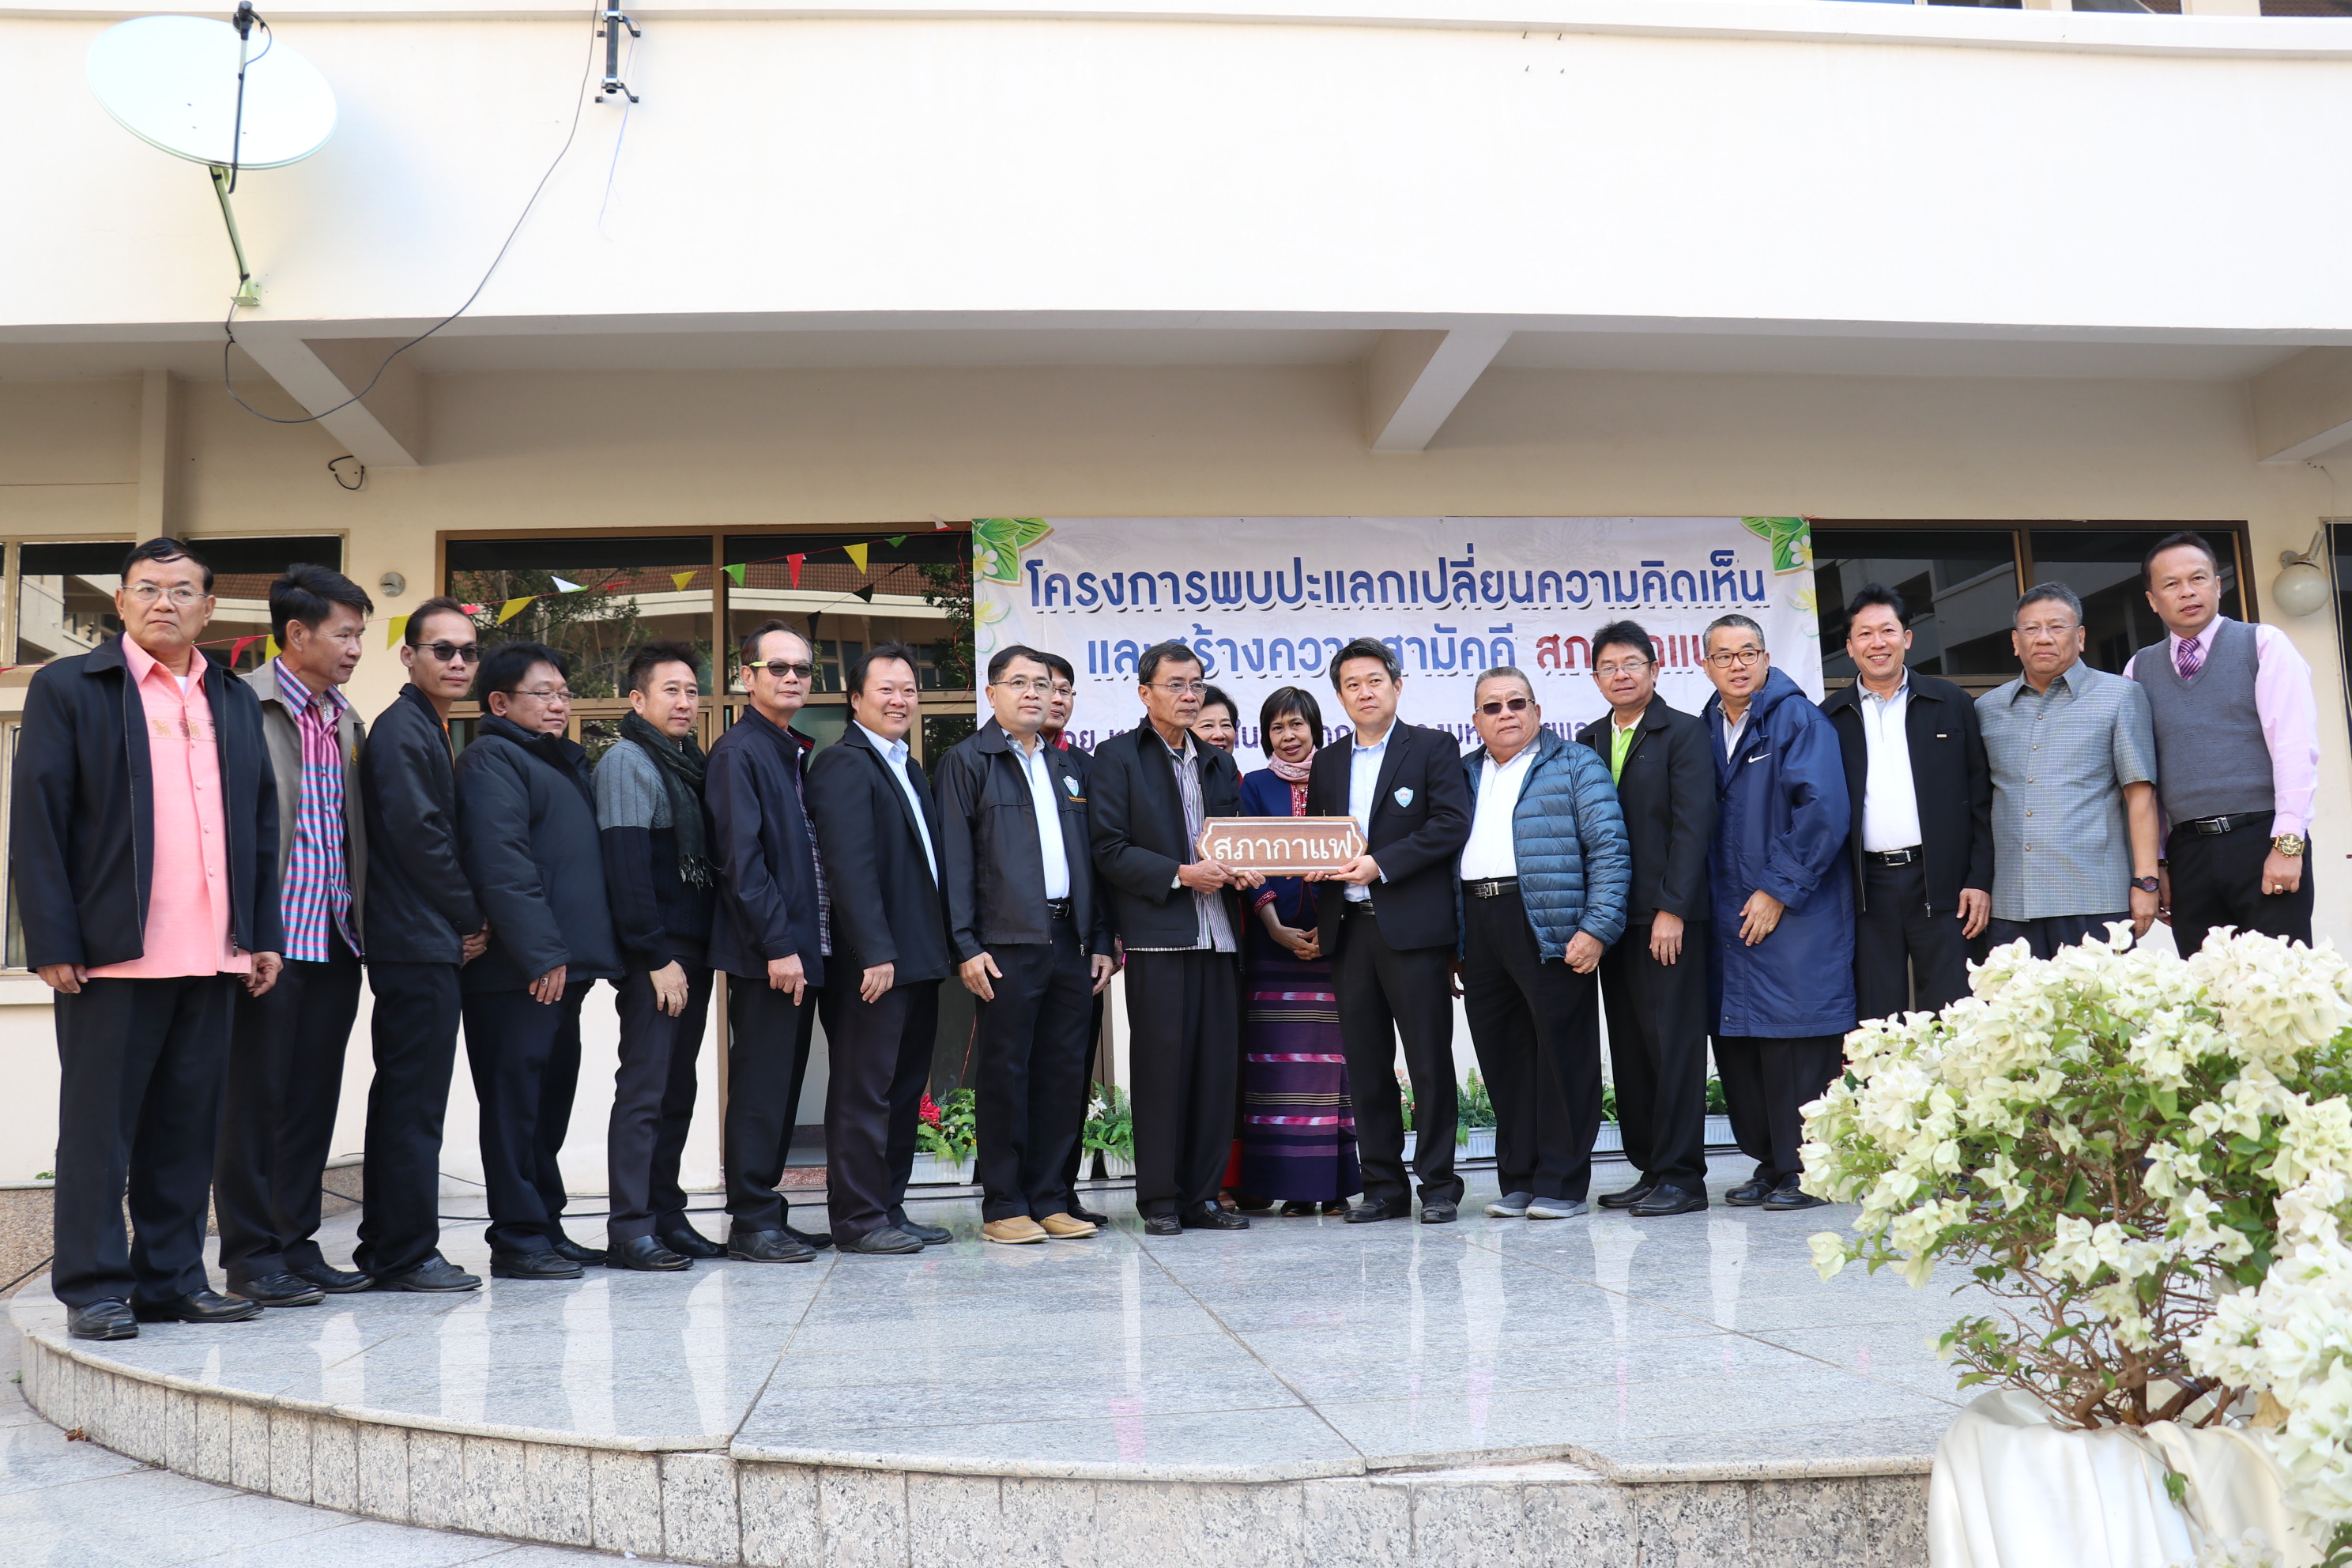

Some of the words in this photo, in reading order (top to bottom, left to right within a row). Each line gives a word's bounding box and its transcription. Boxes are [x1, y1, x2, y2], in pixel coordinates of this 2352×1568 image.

[1025, 543, 1766, 608] โครงการพบปะแลกเปลี่ยนความคิดเห็น
[1213, 830, 1353, 861] สภากาแฟ
